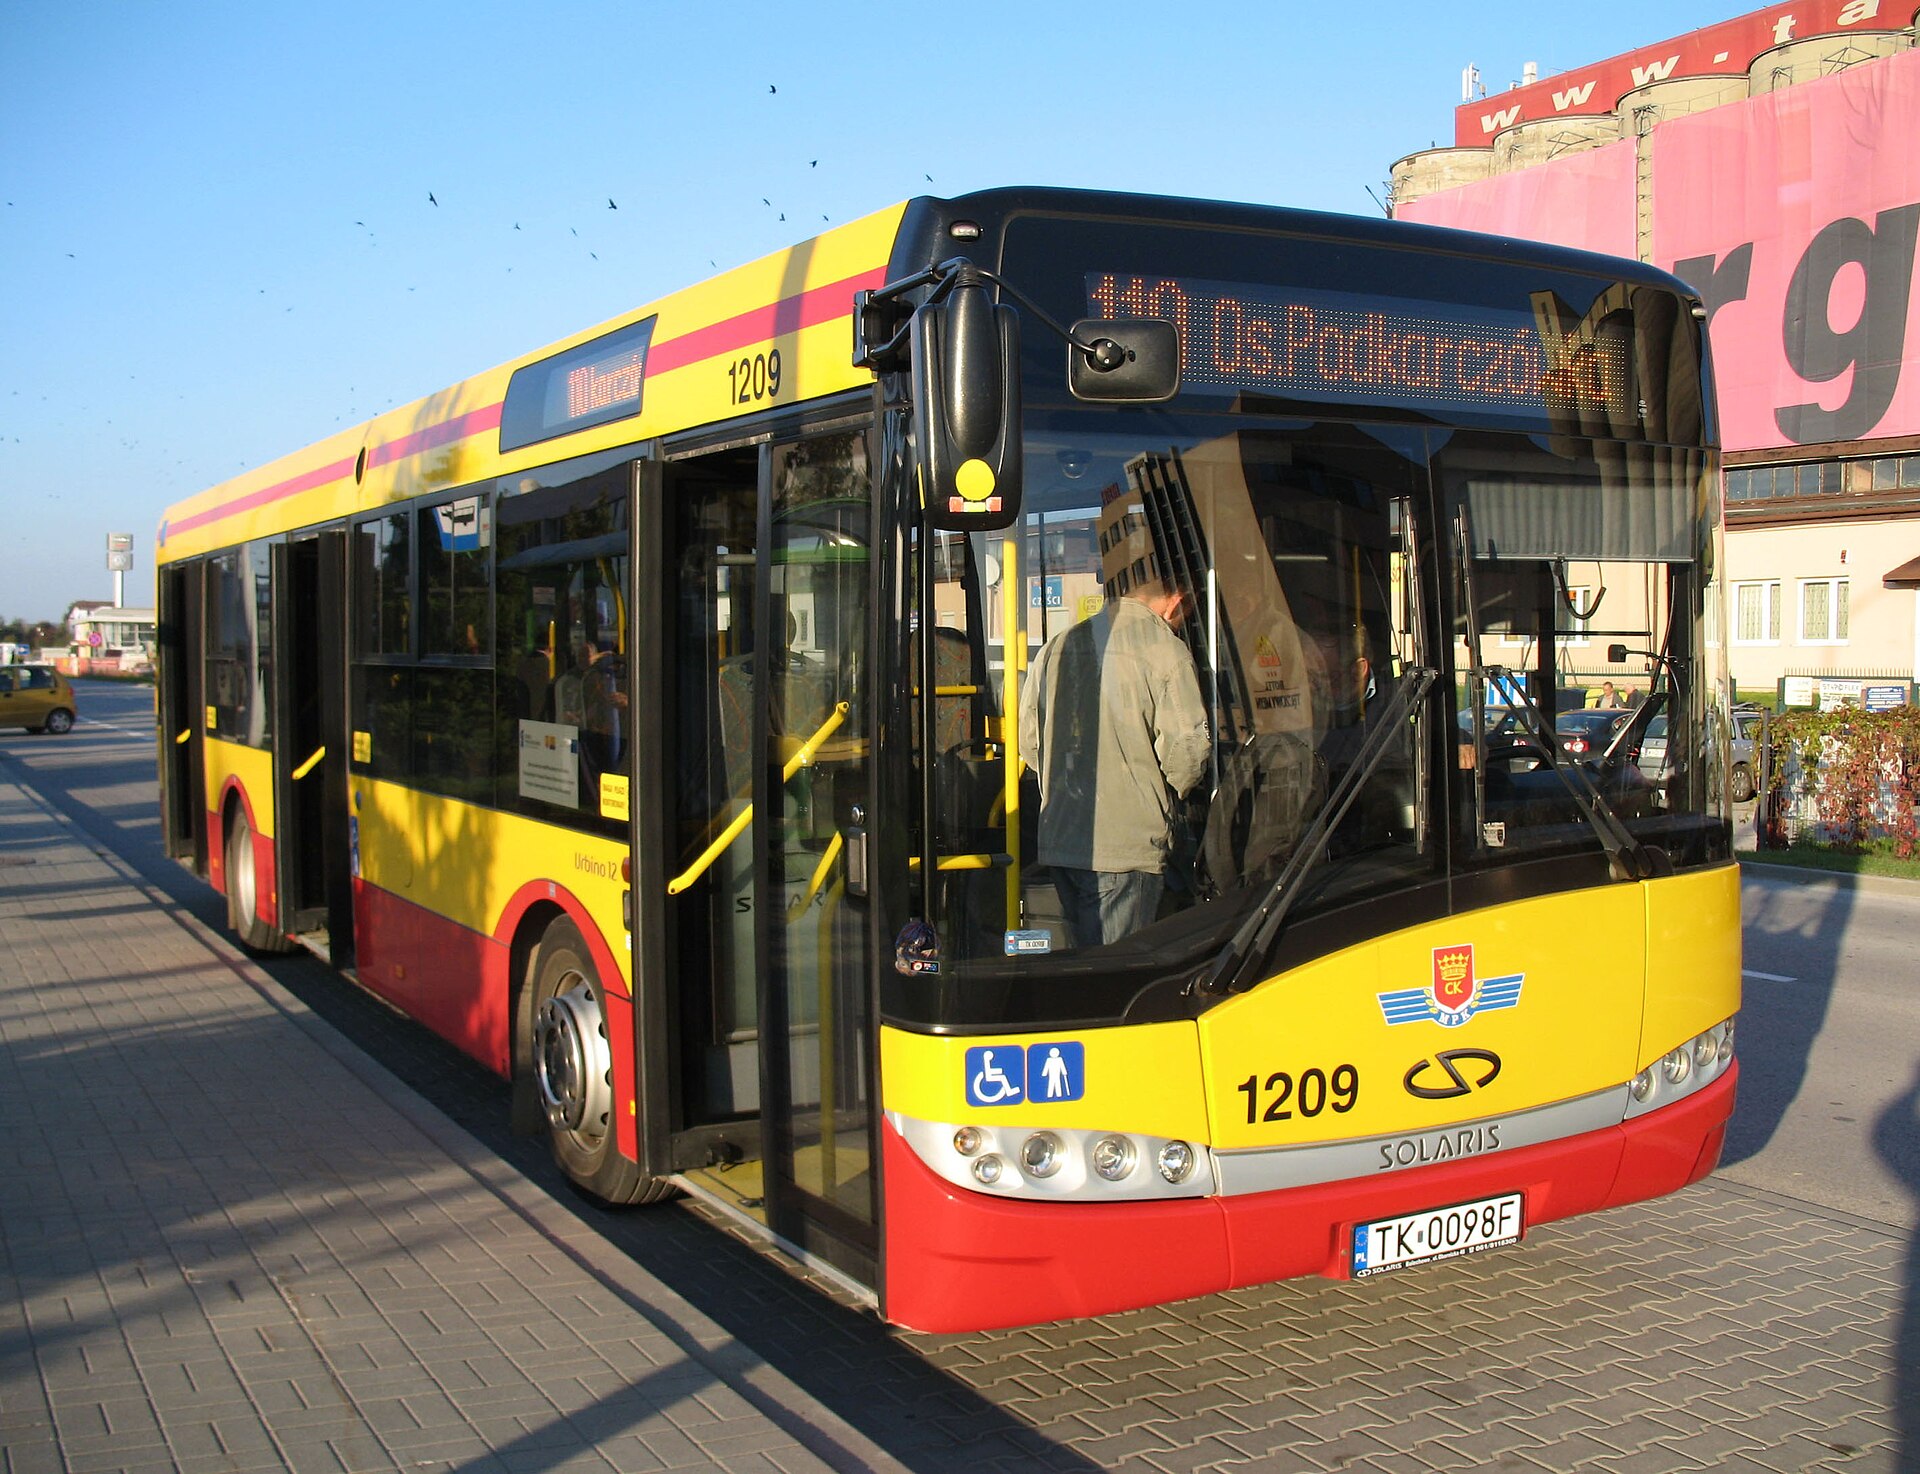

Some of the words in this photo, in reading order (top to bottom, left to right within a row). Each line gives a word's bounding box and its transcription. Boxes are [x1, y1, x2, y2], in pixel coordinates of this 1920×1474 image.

[728, 348, 781, 406] 1209
[1032, 595, 1060, 606] CZŚCI
[575, 852, 605, 877] Urbino
[608, 861, 617, 881] 12
[1444, 980, 1463, 995] CK
[1439, 1008, 1470, 1025] MPK
[1238, 1063, 1359, 1125] 1209
[1379, 1124, 1501, 1170] SOLARIS
[1375, 1220, 1414, 1260] TK
[1428, 1200, 1515, 1250] 0098F
[1355, 1252, 1366, 1264] PL
[1371, 1262, 1402, 1275] SOLARIS
